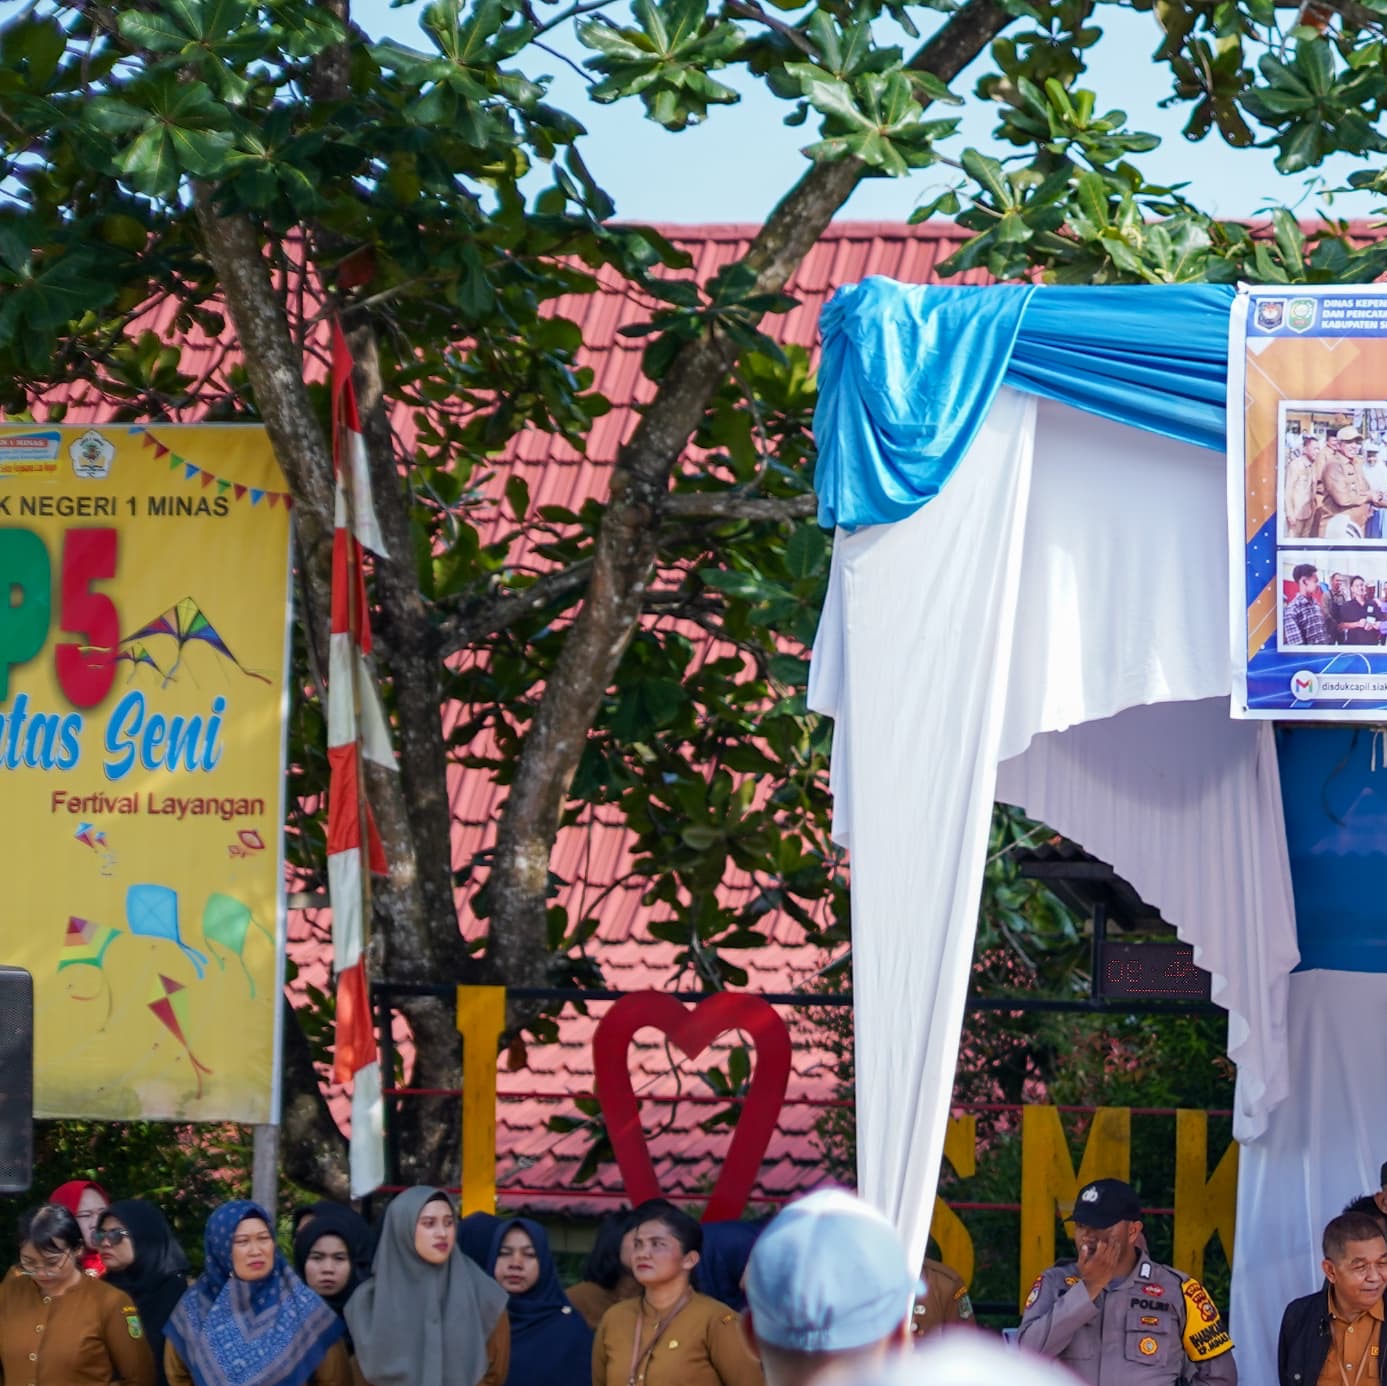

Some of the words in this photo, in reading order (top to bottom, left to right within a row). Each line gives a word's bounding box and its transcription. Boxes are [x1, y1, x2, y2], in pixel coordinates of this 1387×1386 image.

[1323, 299, 1354, 308] DINAS
[1322, 310, 1345, 319] DAN
[1321, 320, 1378, 329] KABUPATEN
[19, 495, 117, 517] NEGERI
[126, 496, 137, 516] 1
[148, 496, 230, 517] MINAS
[103, 689, 227, 781] Seni
[50, 790, 139, 816] Fertival
[147, 792, 265, 820] Layangan
[1130, 1297, 1171, 1312] POLRI
